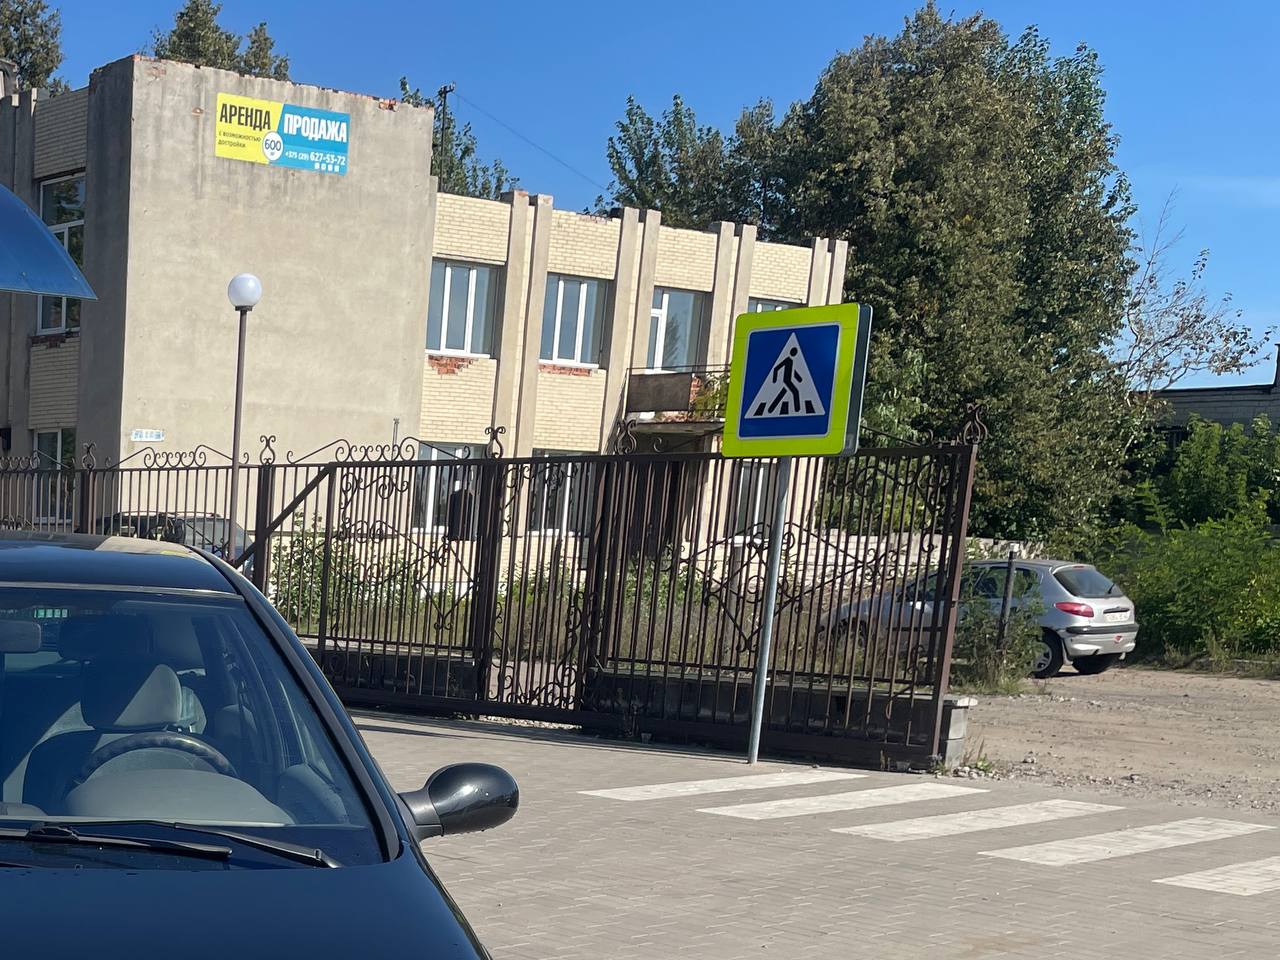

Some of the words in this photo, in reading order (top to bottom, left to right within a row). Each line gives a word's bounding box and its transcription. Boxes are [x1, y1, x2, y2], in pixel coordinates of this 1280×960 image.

[220, 103, 271, 131] АРЕНДА
[283, 113, 348, 143] ПРОДАЖА
[264, 139, 282, 152] 600
[310, 151, 346, 166] 627-53-72
